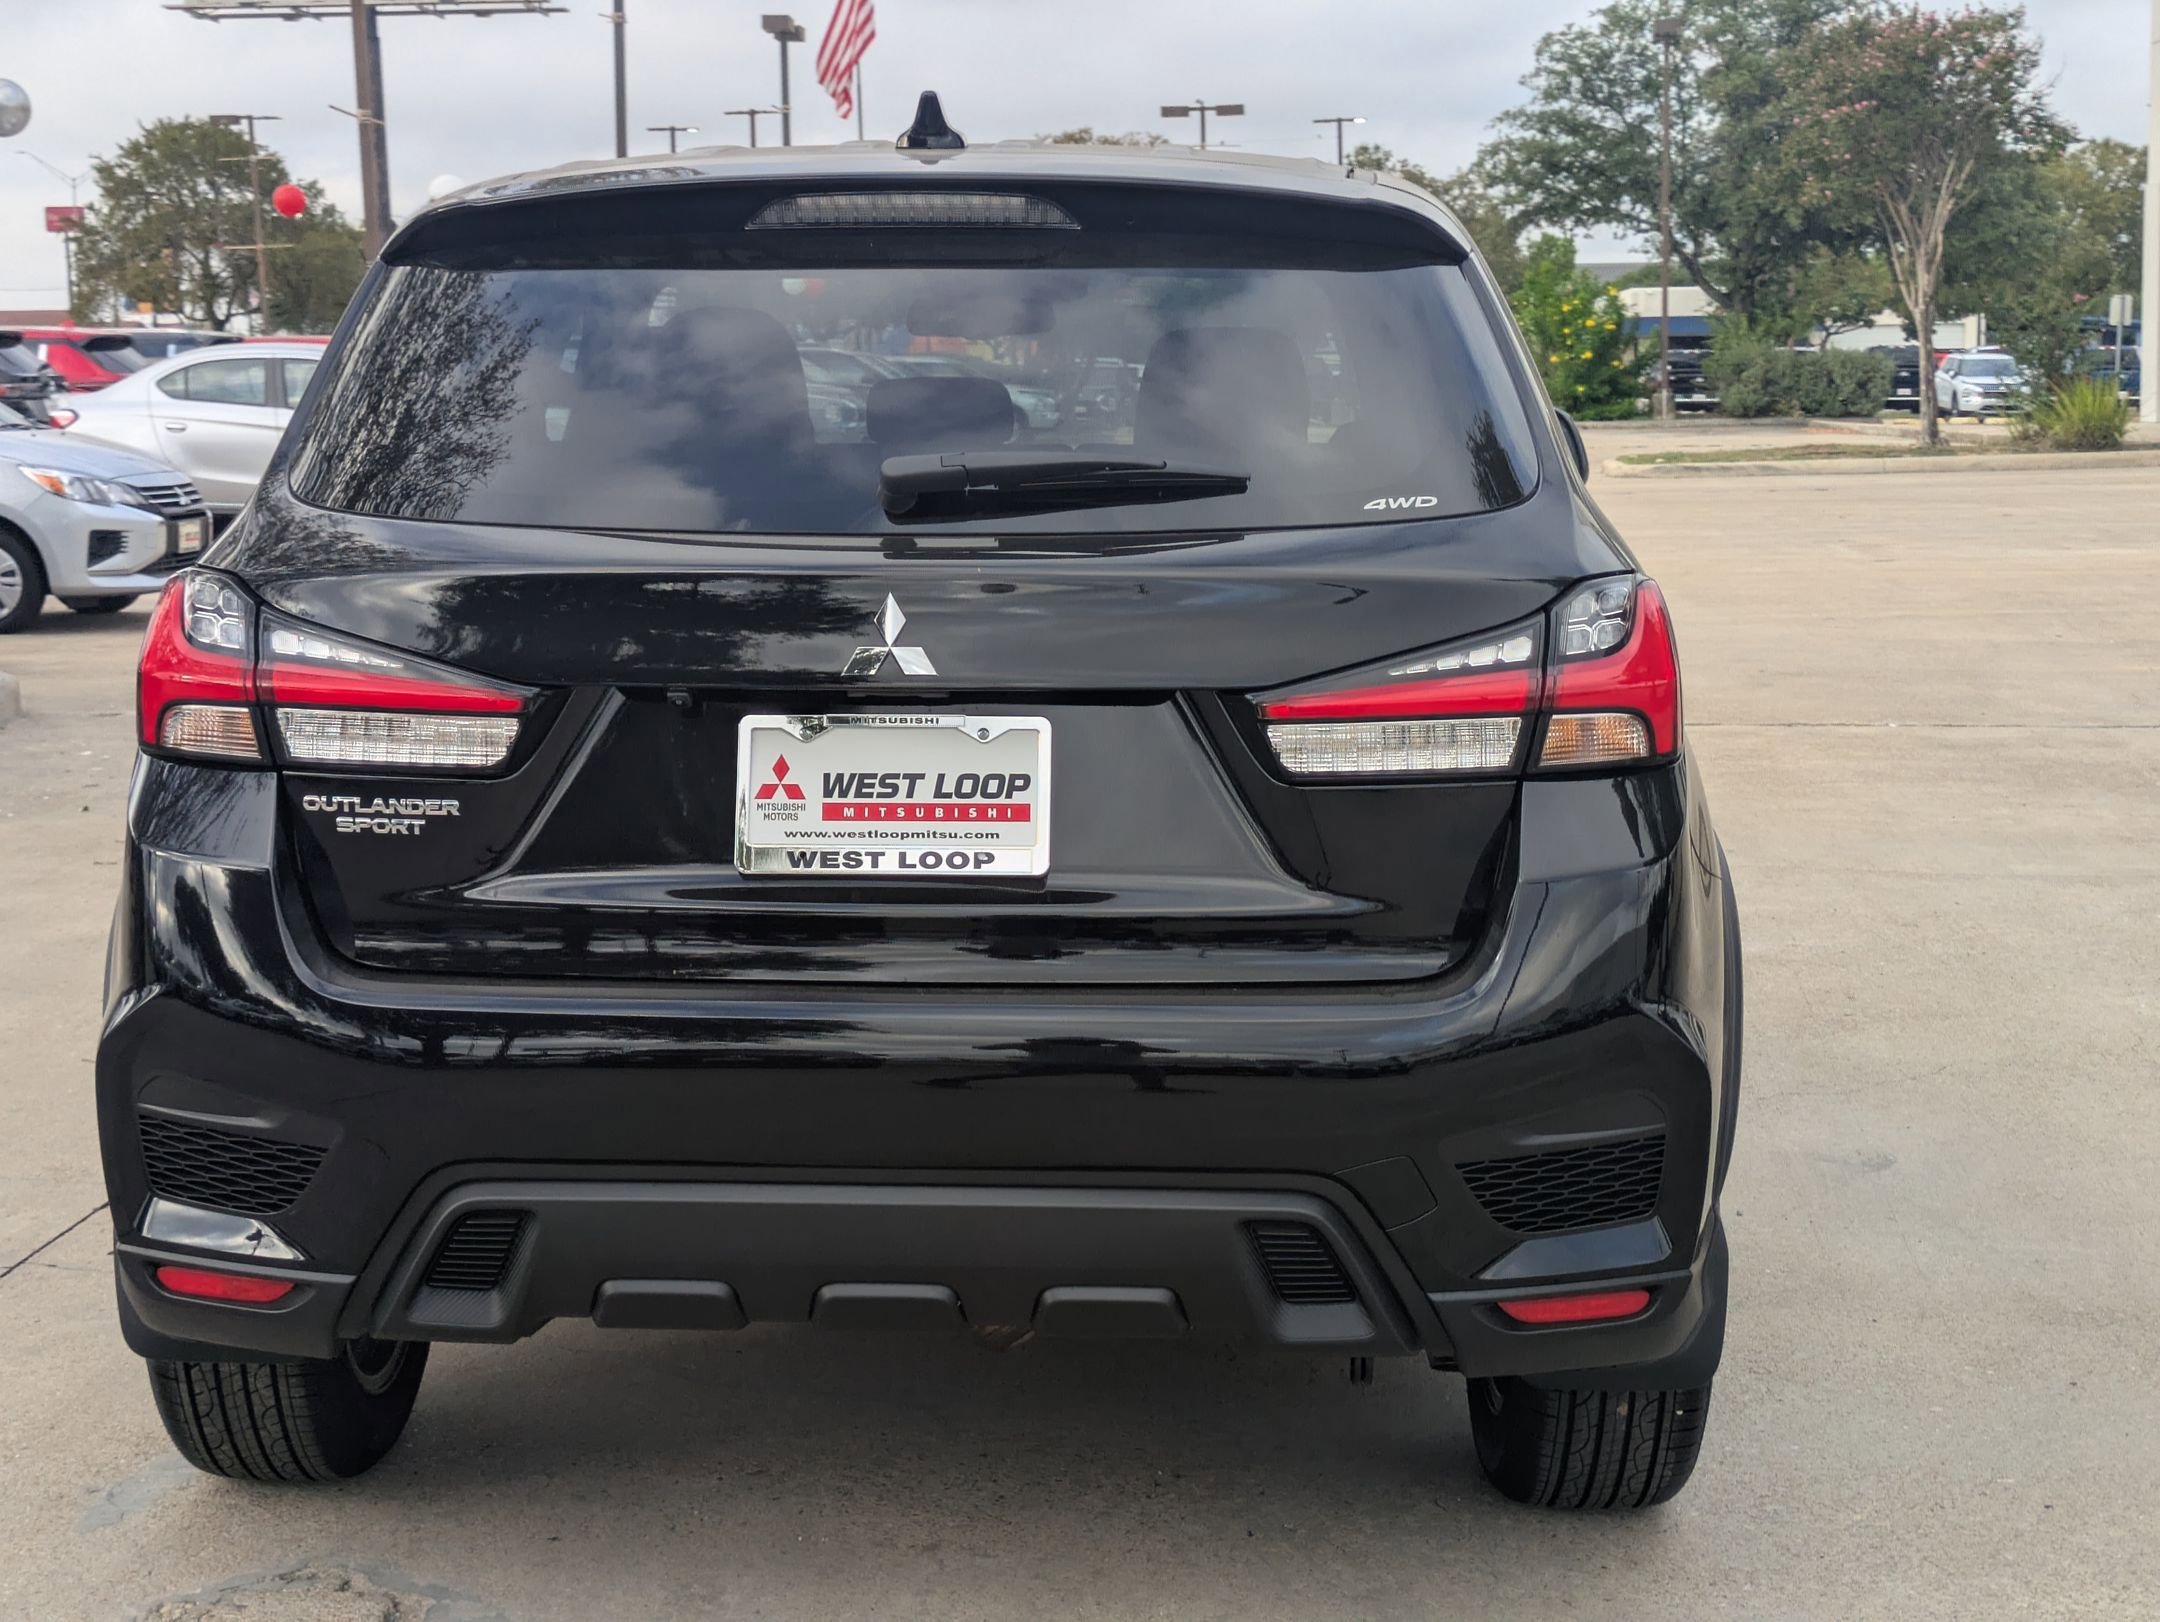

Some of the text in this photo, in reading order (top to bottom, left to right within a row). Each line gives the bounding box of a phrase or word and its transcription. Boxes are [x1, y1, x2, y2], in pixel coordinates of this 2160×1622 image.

[1363, 496, 1438, 510] 4WD
[849, 717, 940, 725] MITSUBISHI
[822, 772, 1031, 799] WEST LOOP
[303, 795, 461, 816] OUTLANDER
[756, 803, 806, 812] MITSUBISHI
[763, 812, 799, 821] MOTORS
[843, 806, 1012, 819] MITSUBISHI
[335, 816, 426, 835] SPORT
[784, 829, 1000, 841] www.westloopmitsu.com
[787, 850, 995, 870] WEST LOOP
